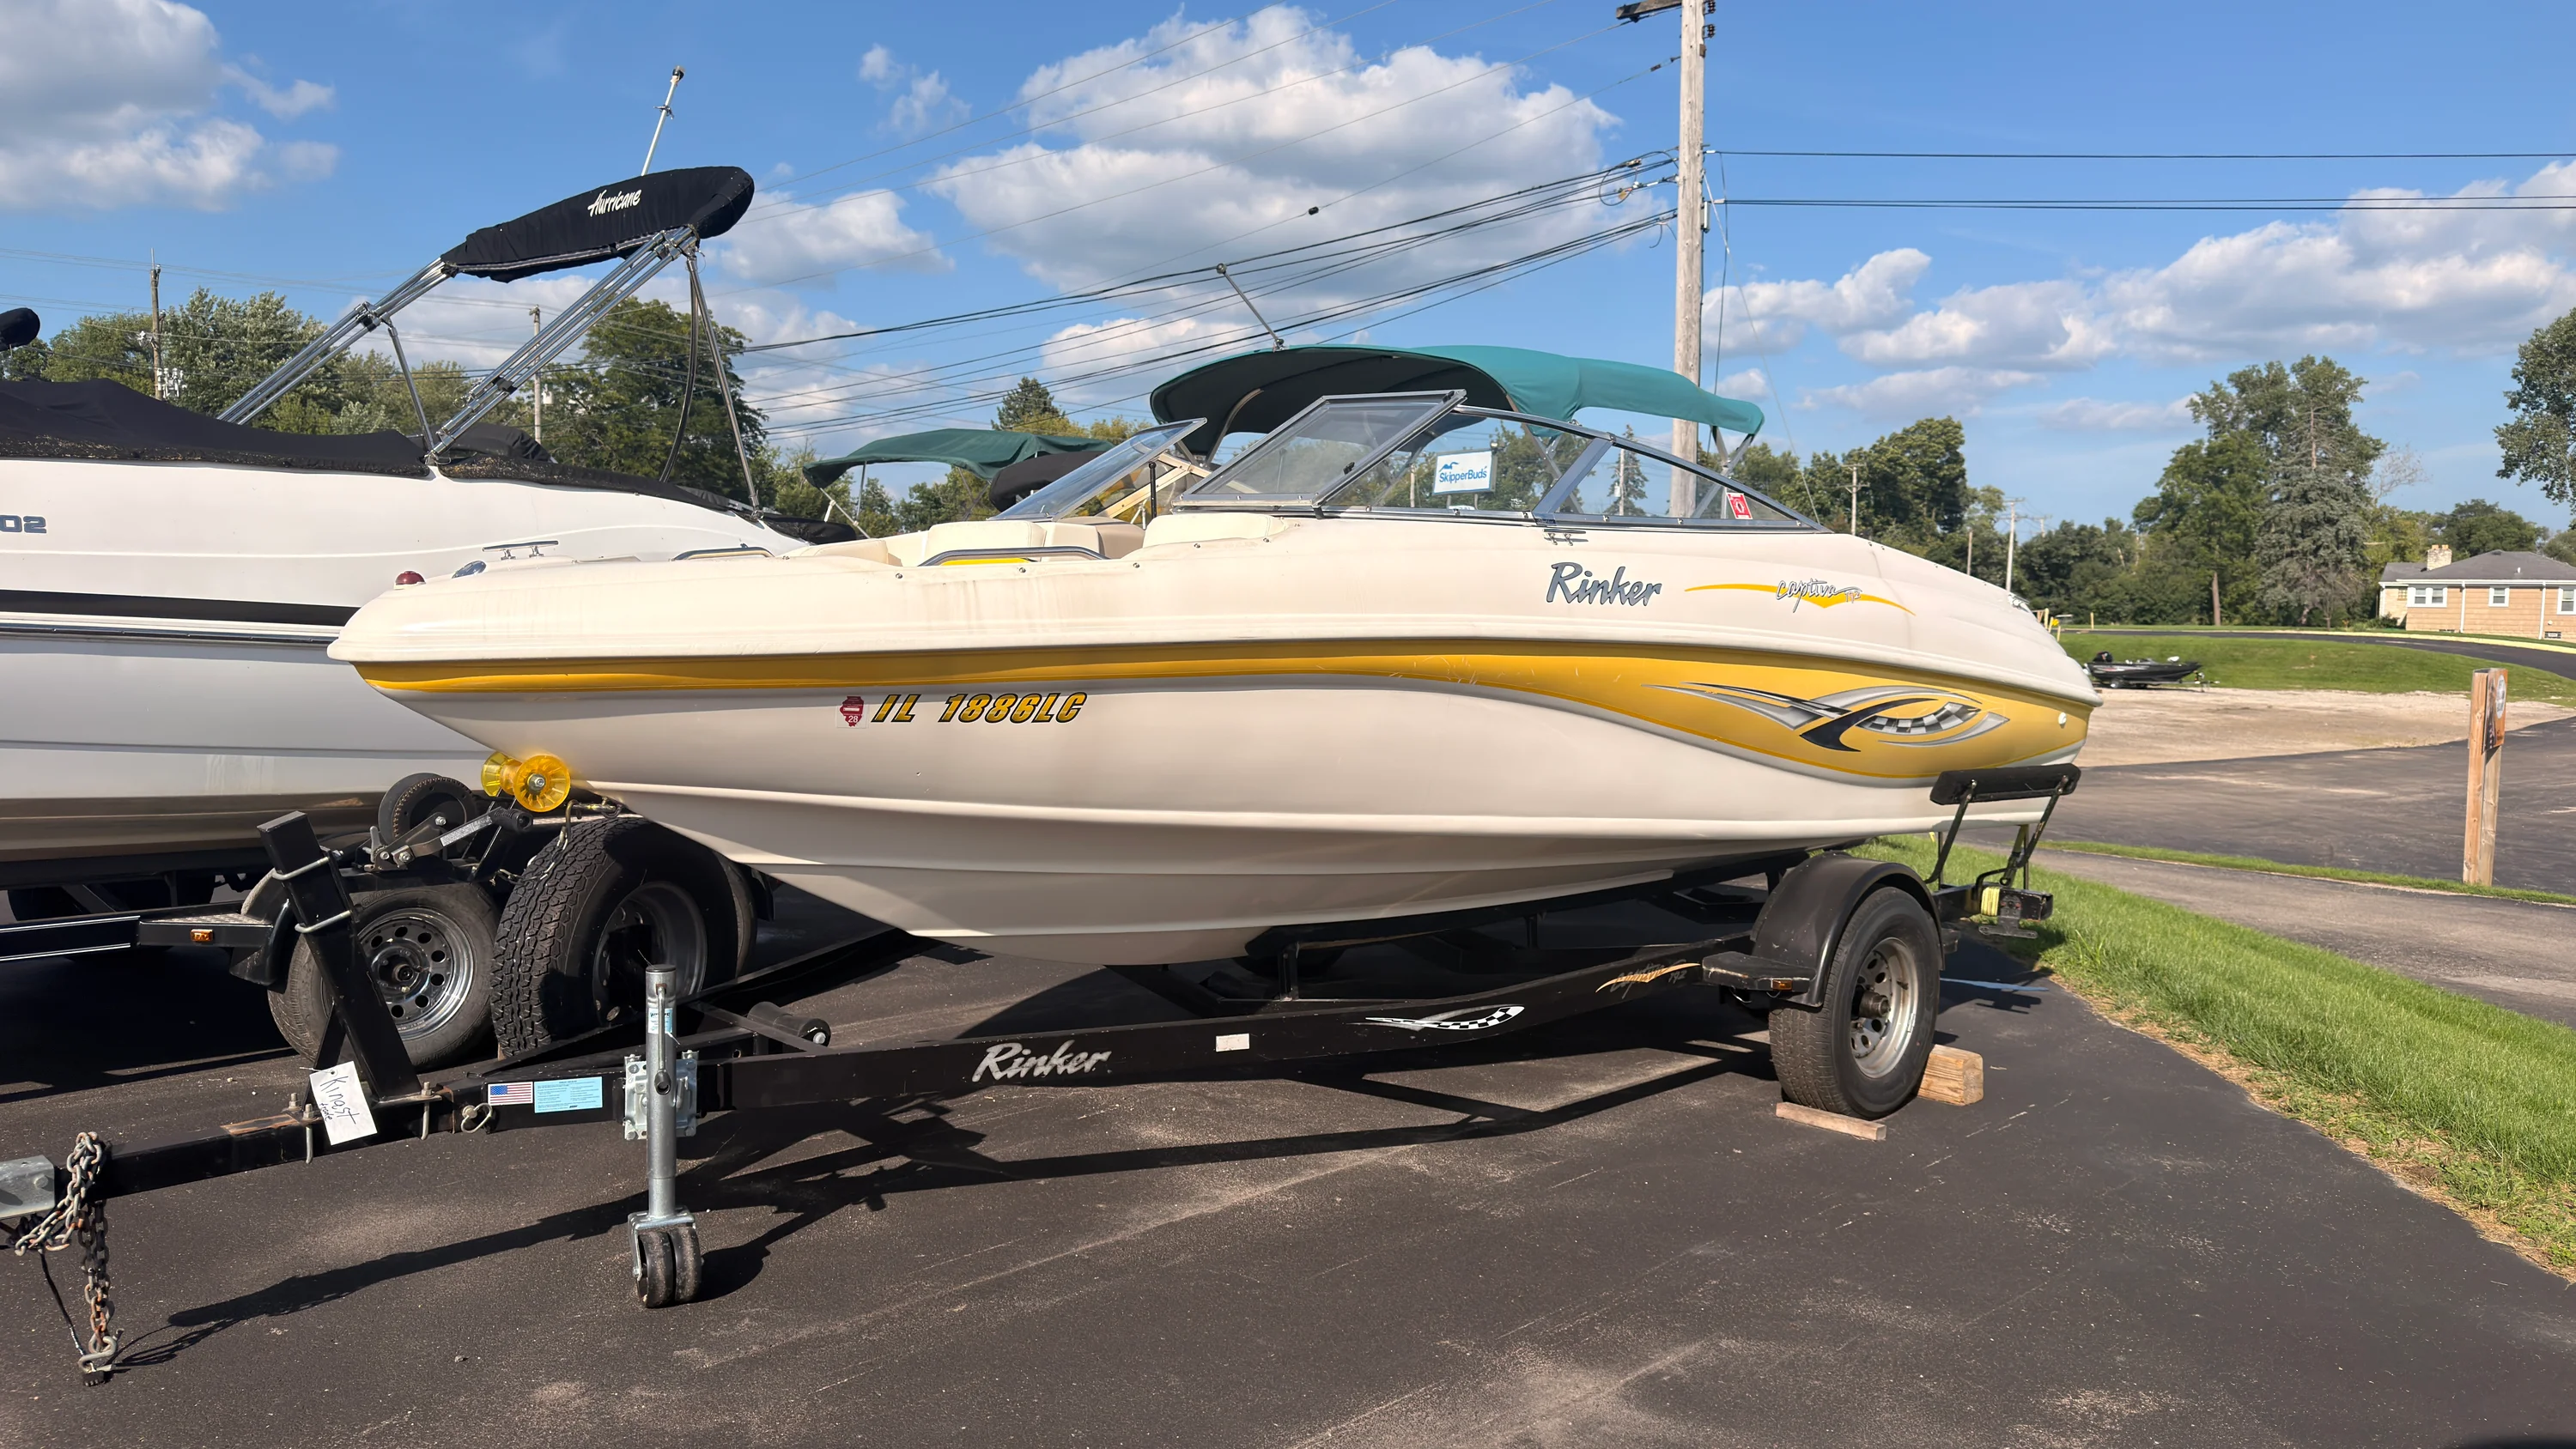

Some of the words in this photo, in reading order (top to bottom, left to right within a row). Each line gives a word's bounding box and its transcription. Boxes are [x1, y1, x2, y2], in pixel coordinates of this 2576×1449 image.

[587, 190, 642, 217] Hurricane
[1546, 561, 1663, 606] Rinker
[848, 715, 859, 724] 28
[871, 694, 922, 723] IL
[938, 692, 1088, 724] 1886LC
[972, 1040, 1112, 1082] Rinker
